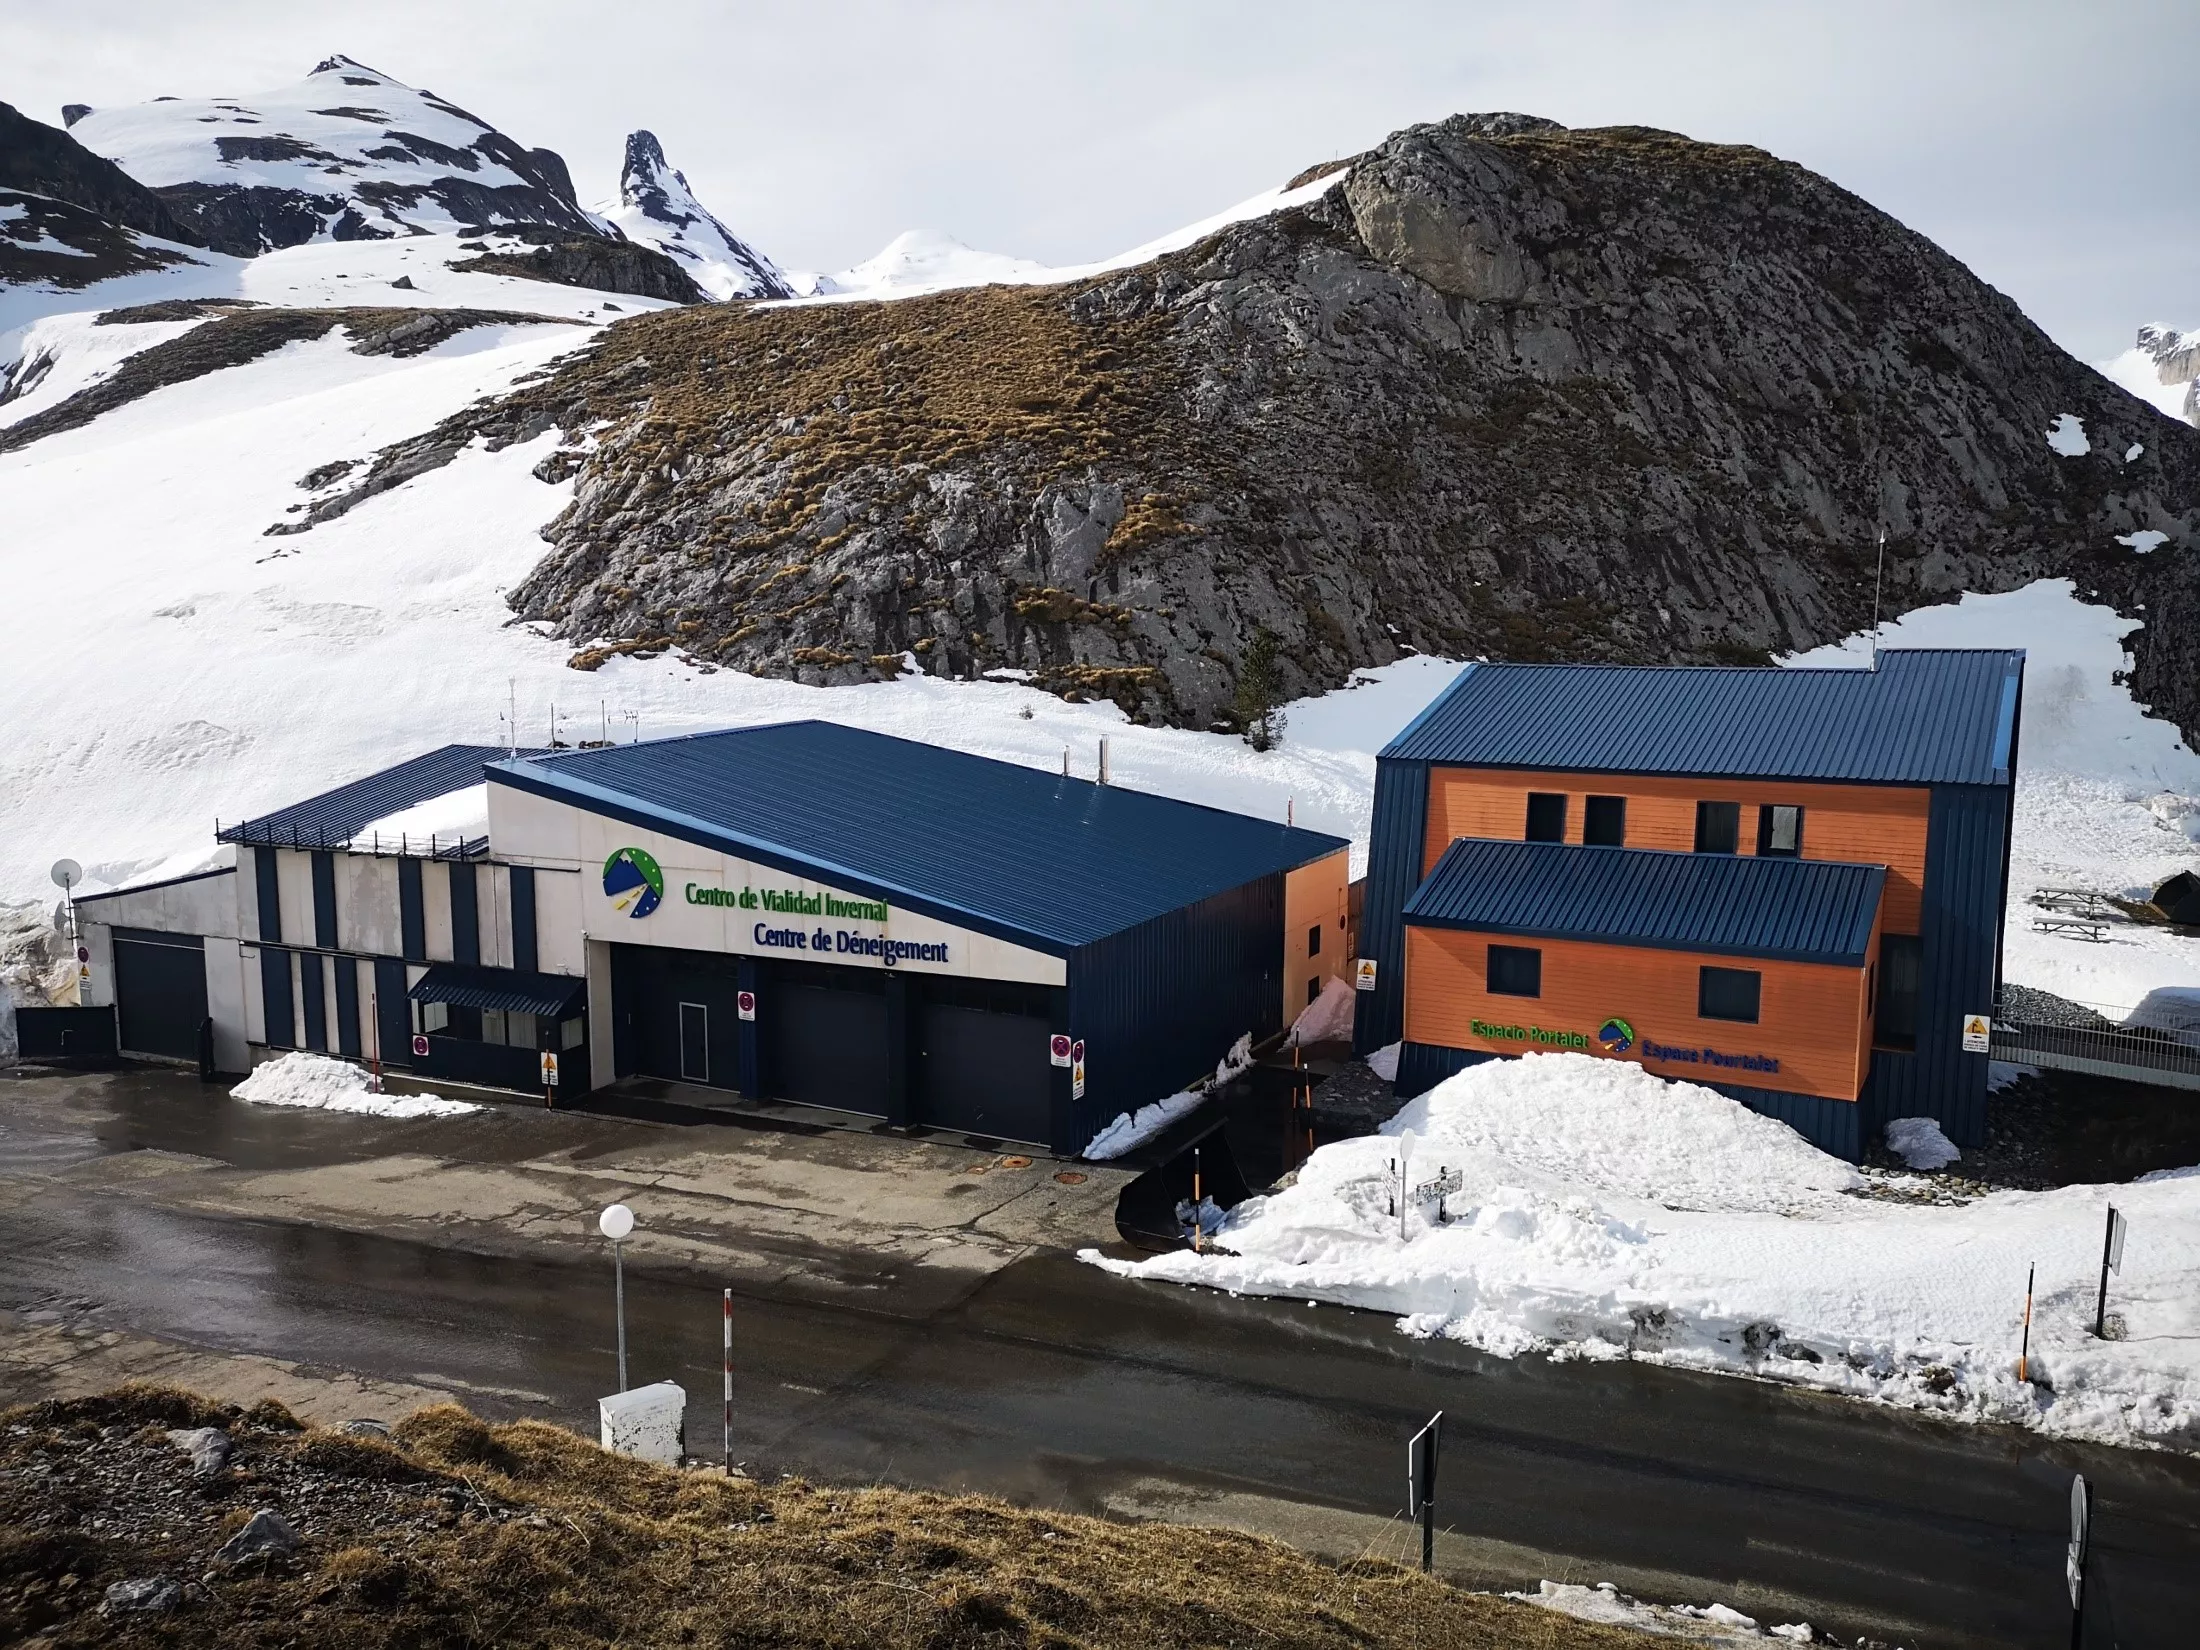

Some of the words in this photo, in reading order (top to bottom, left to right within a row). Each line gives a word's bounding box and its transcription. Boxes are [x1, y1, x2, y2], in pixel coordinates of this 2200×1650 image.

[685, 883, 735, 908] Centro
[739, 886, 758, 910] de
[760, 889, 821, 916] Vialidad
[825, 893, 888, 922] Invernal
[754, 923, 807, 949] Centre
[811, 927, 832, 952] de
[836, 930, 949, 967] Déneigement
[1470, 1019, 1526, 1041] Espacio
[1529, 1025, 1589, 1049] Portalet
[1642, 1039, 1699, 1063] Espace
[1703, 1047, 1779, 1073] Pourtalet
